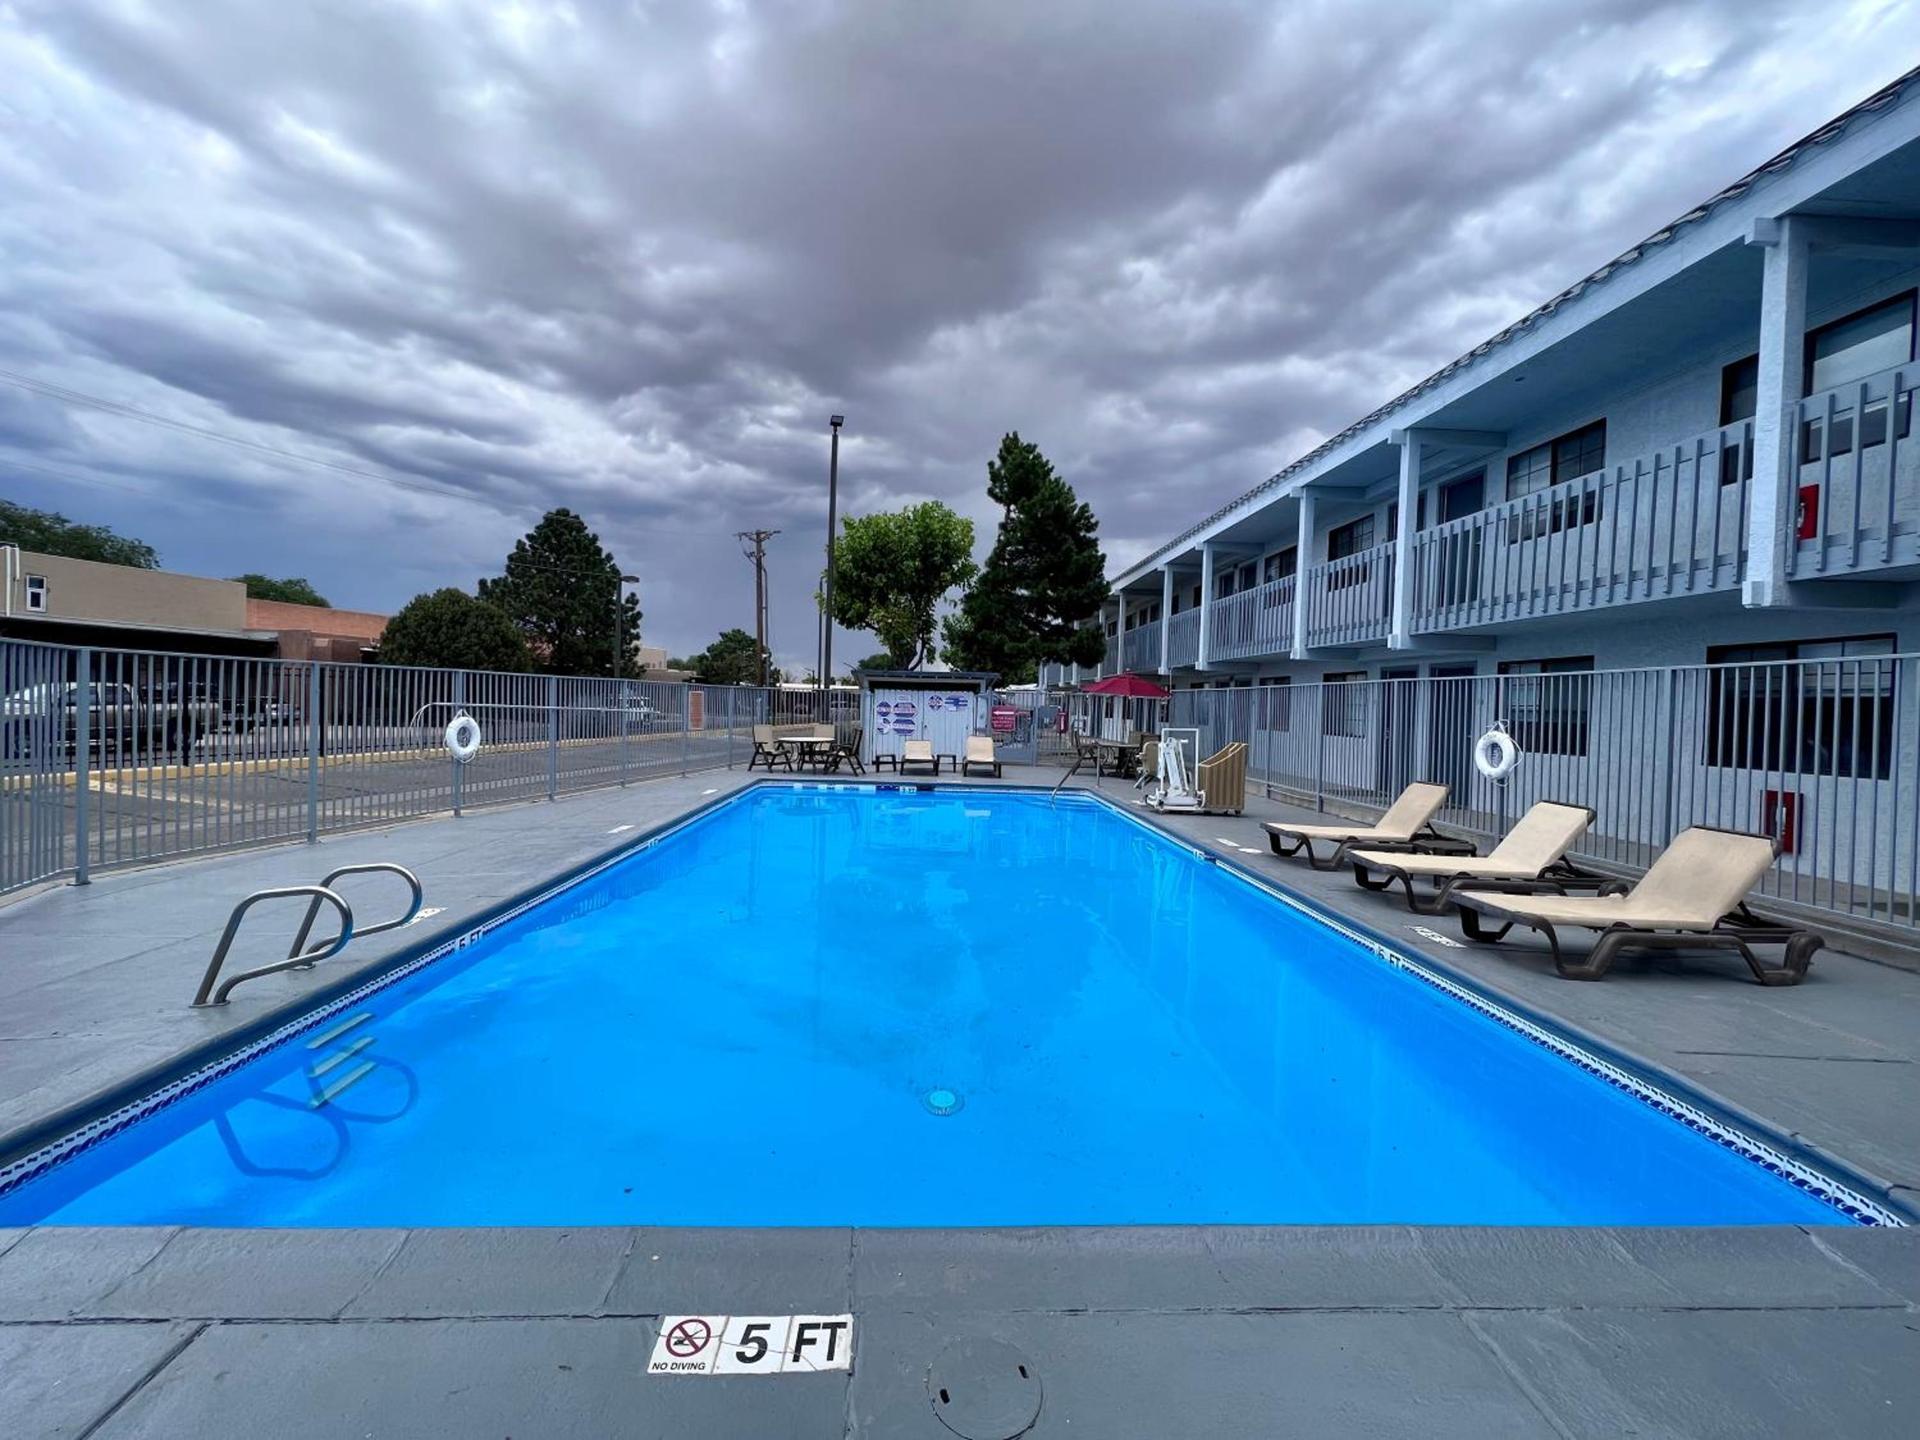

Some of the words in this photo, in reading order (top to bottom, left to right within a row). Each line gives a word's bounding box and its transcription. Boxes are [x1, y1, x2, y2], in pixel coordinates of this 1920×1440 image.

[735, 1323, 771, 1364] 5
[792, 1321, 848, 1363] FT
[652, 1362, 668, 1371] NO
[670, 1362, 706, 1371] DIVING
